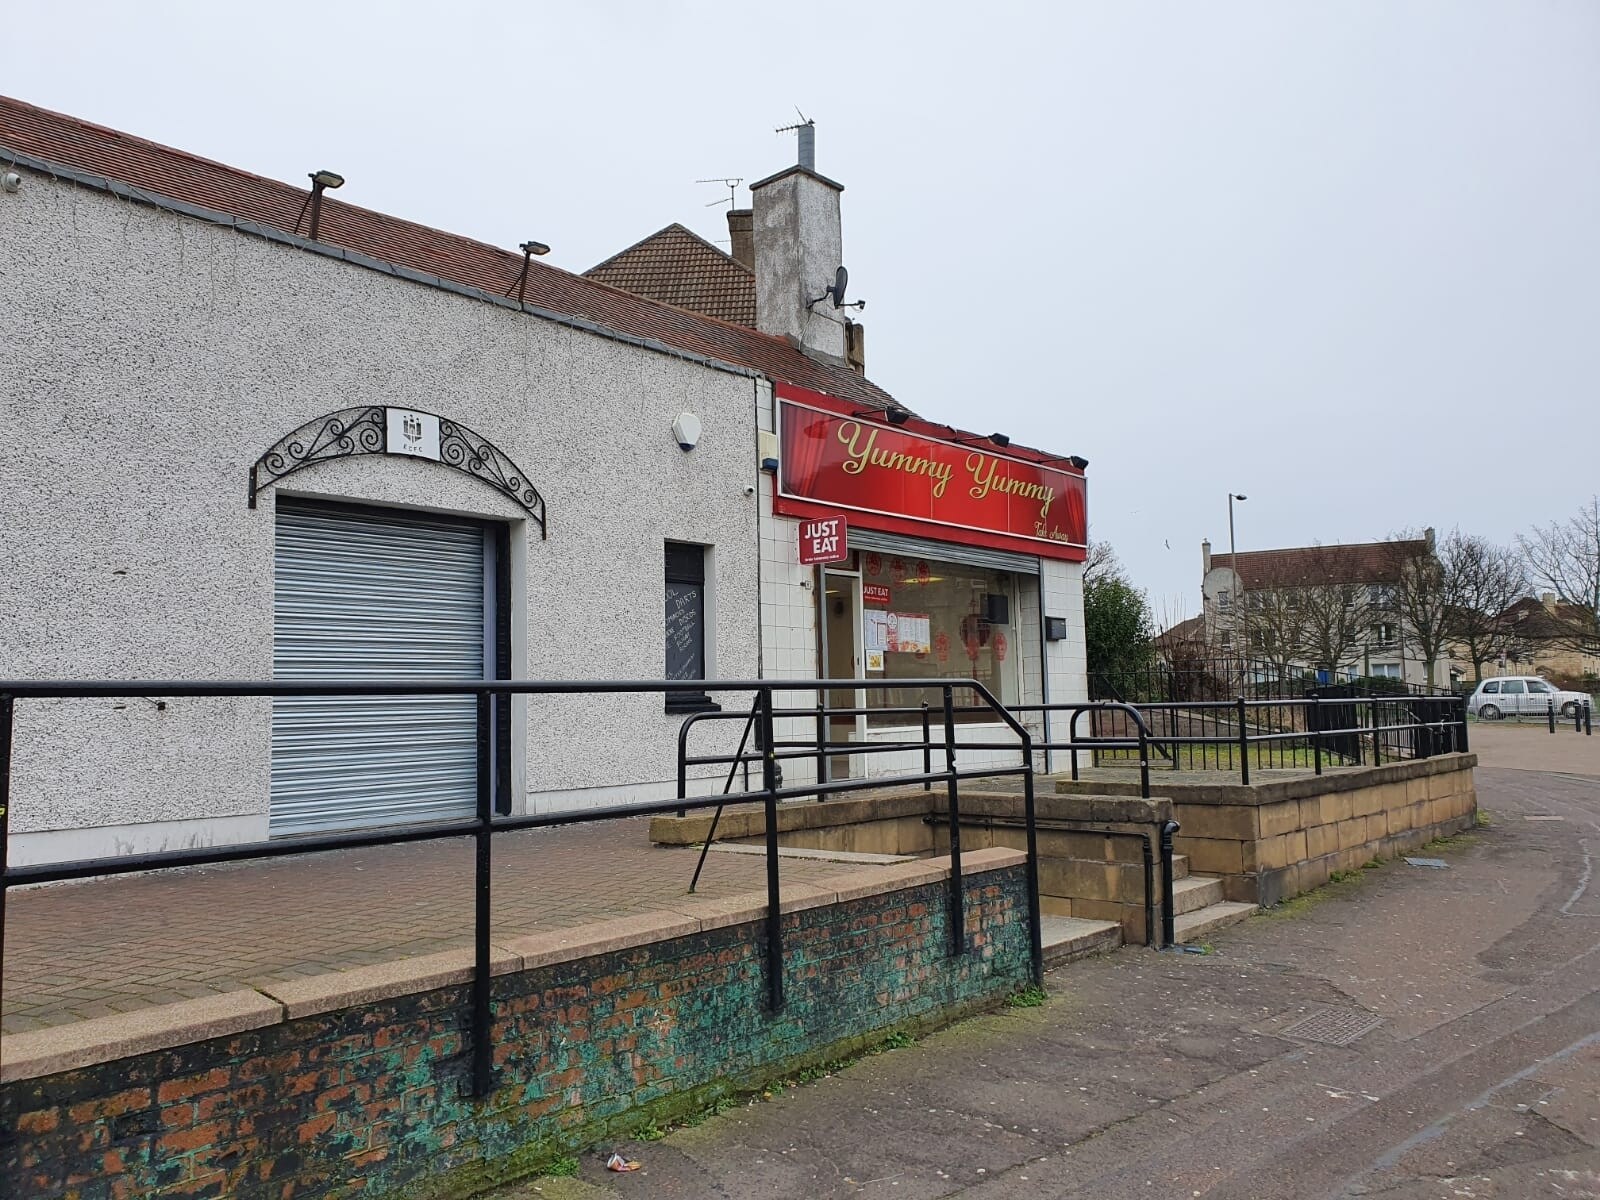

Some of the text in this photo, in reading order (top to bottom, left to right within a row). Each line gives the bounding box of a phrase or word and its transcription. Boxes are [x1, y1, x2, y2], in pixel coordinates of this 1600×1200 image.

[837, 421, 1055, 518] Yummy Yummy
[805, 520, 838, 539] JUST
[1034, 520, 1068, 543] Take Away
[813, 536, 838, 553] EAT
[675, 591, 696, 609] DARTS
[863, 586, 889, 597] JUST EAT
